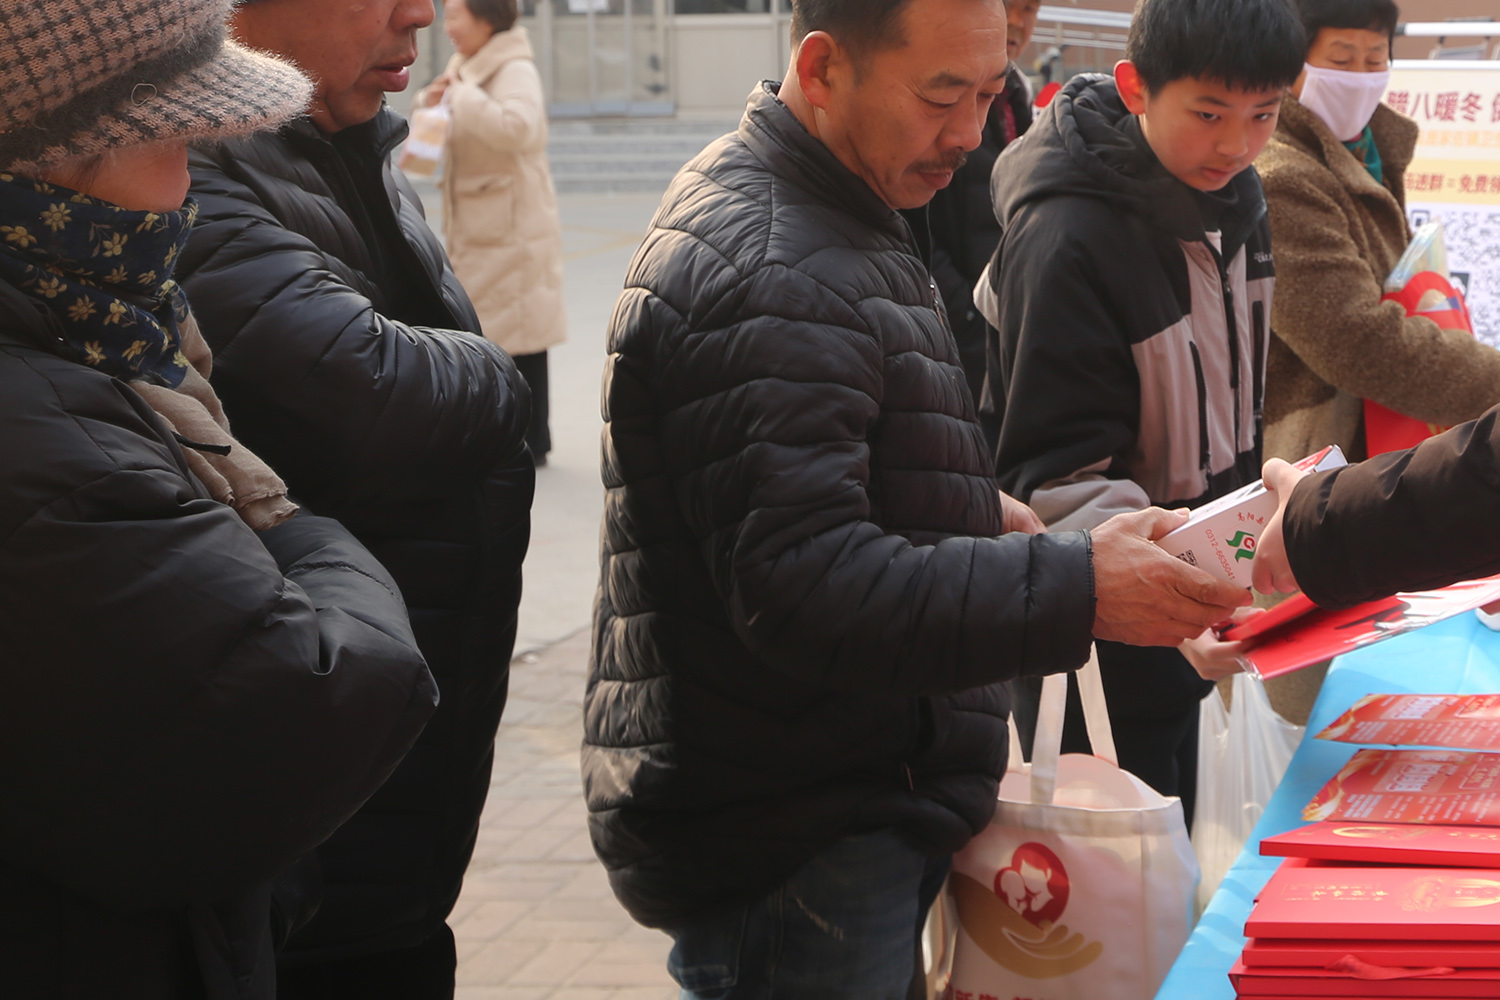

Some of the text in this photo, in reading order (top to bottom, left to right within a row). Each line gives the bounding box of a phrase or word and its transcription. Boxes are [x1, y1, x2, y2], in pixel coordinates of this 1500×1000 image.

[1387, 91, 1482, 123] 腊八暖冬
[1205, 529, 1236, 581] 0312-6635041
